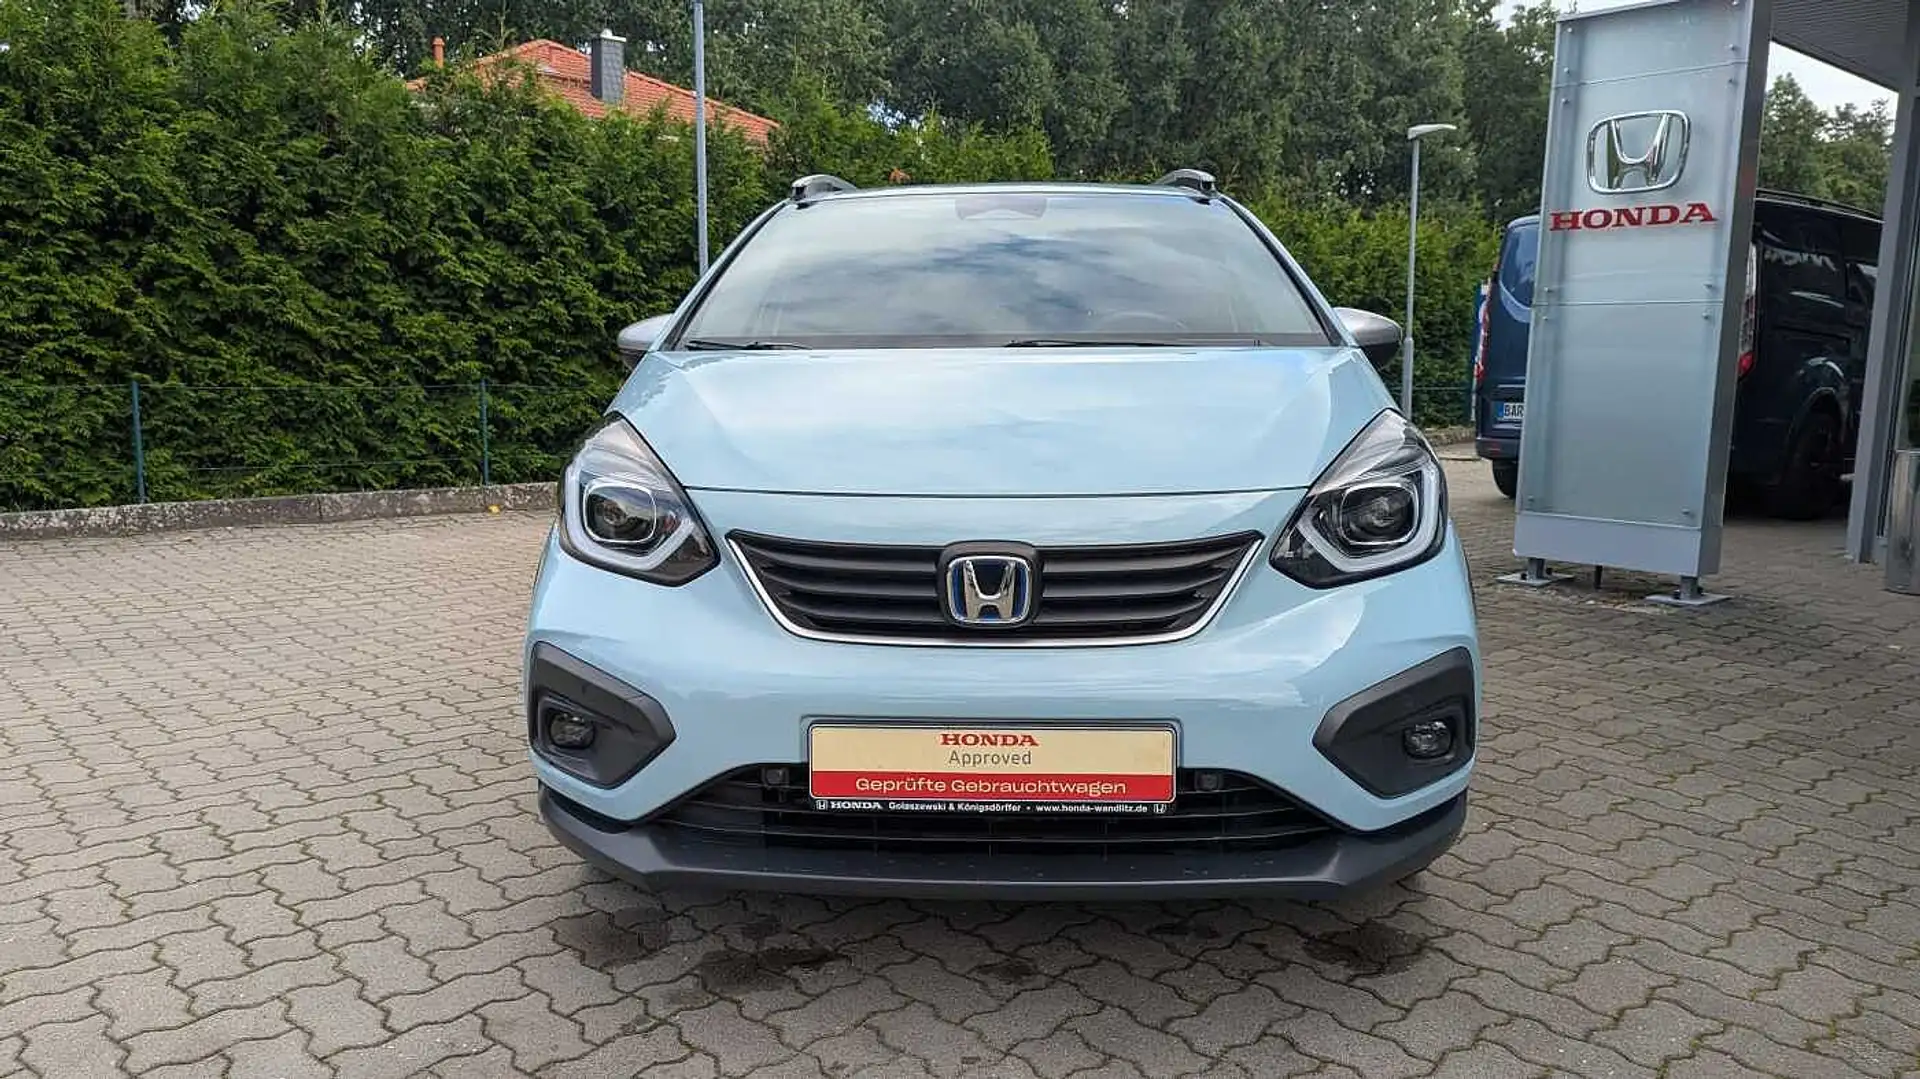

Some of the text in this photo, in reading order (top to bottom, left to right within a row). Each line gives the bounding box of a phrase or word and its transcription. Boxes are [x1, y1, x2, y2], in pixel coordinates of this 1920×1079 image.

[1550, 203, 1718, 231] HONDA
[940, 733, 1039, 747] HONDA
[949, 750, 1032, 767] Approved
[856, 777, 1126, 797] Geprüfte Gebrauchtwagen
[830, 801, 883, 810] HONDA
[1035, 804, 1148, 813] www.honda-wandlitz.de
